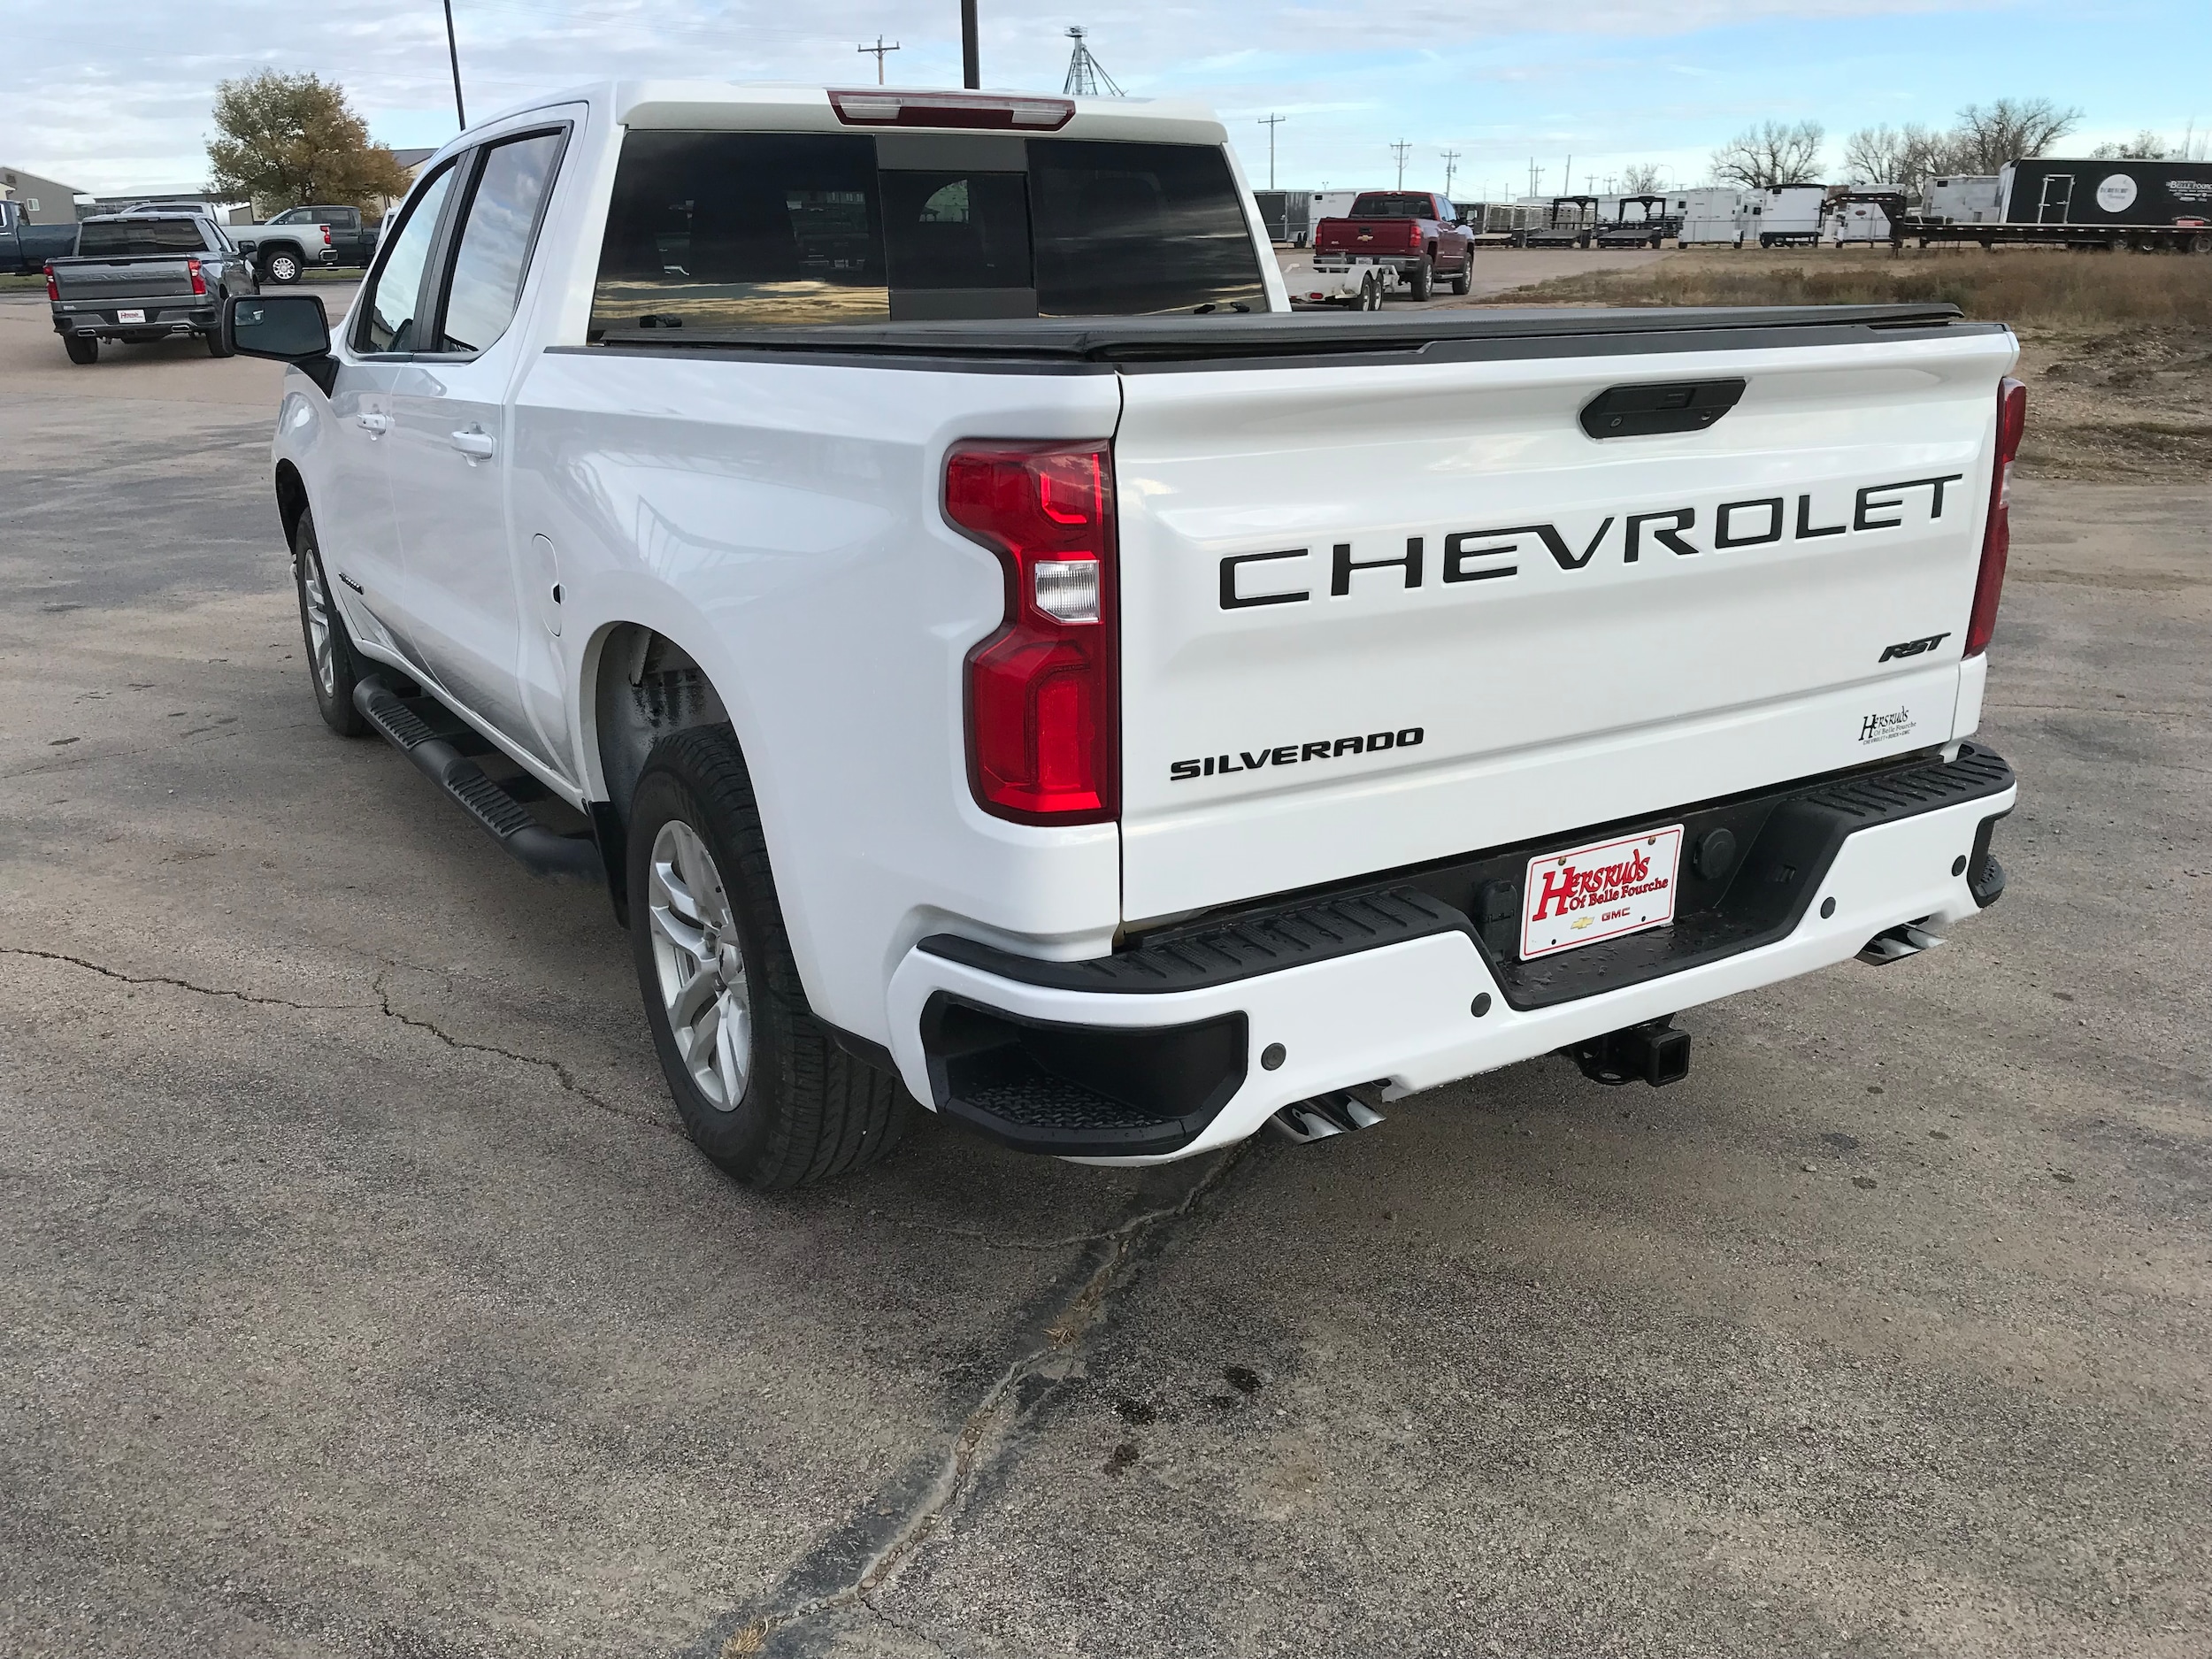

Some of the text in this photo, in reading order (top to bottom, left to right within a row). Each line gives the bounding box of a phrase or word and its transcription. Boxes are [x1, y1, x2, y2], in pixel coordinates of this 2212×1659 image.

[1219, 473, 1962, 611] CHEVROLET
[1878, 632, 1952, 663] RST
[1882, 726, 1895, 735] Belle
[1170, 726, 1425, 781] SILVERADO
[1569, 877, 1670, 911] Of Belle Fourche
[1601, 906, 1631, 922] GMC
